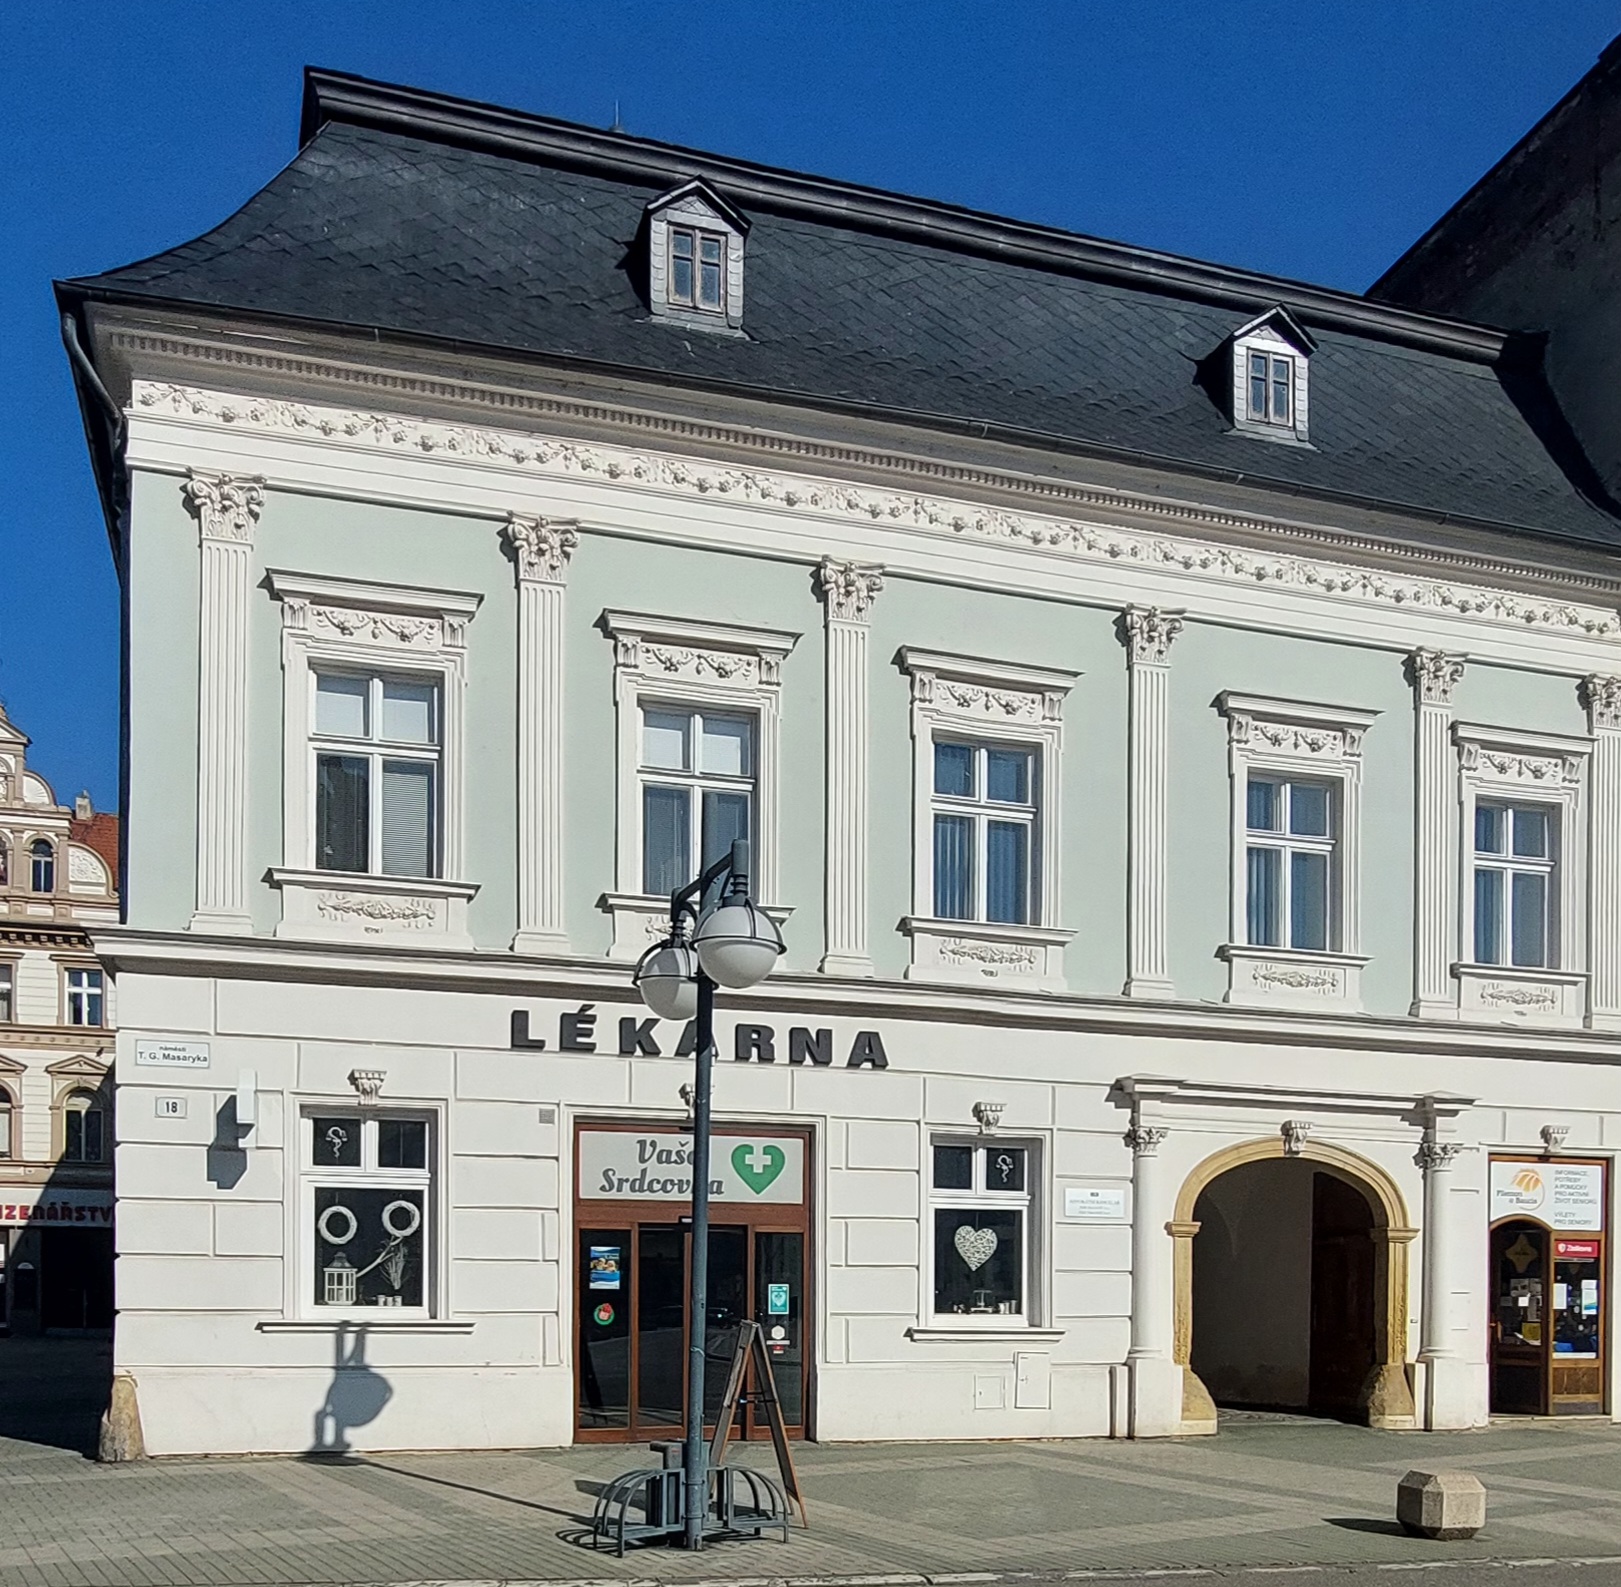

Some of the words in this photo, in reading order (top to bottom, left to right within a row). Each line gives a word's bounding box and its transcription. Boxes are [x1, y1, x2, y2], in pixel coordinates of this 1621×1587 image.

[138, 1051, 146, 1060] T.
[149, 1052, 160, 1060] G.
[162, 1053, 208, 1063] Masaryka
[165, 1101, 178, 1113] 18
[599, 1167, 724, 1195] Srdcova
[0, 1201, 112, 1222] ZENÁŘSTV
